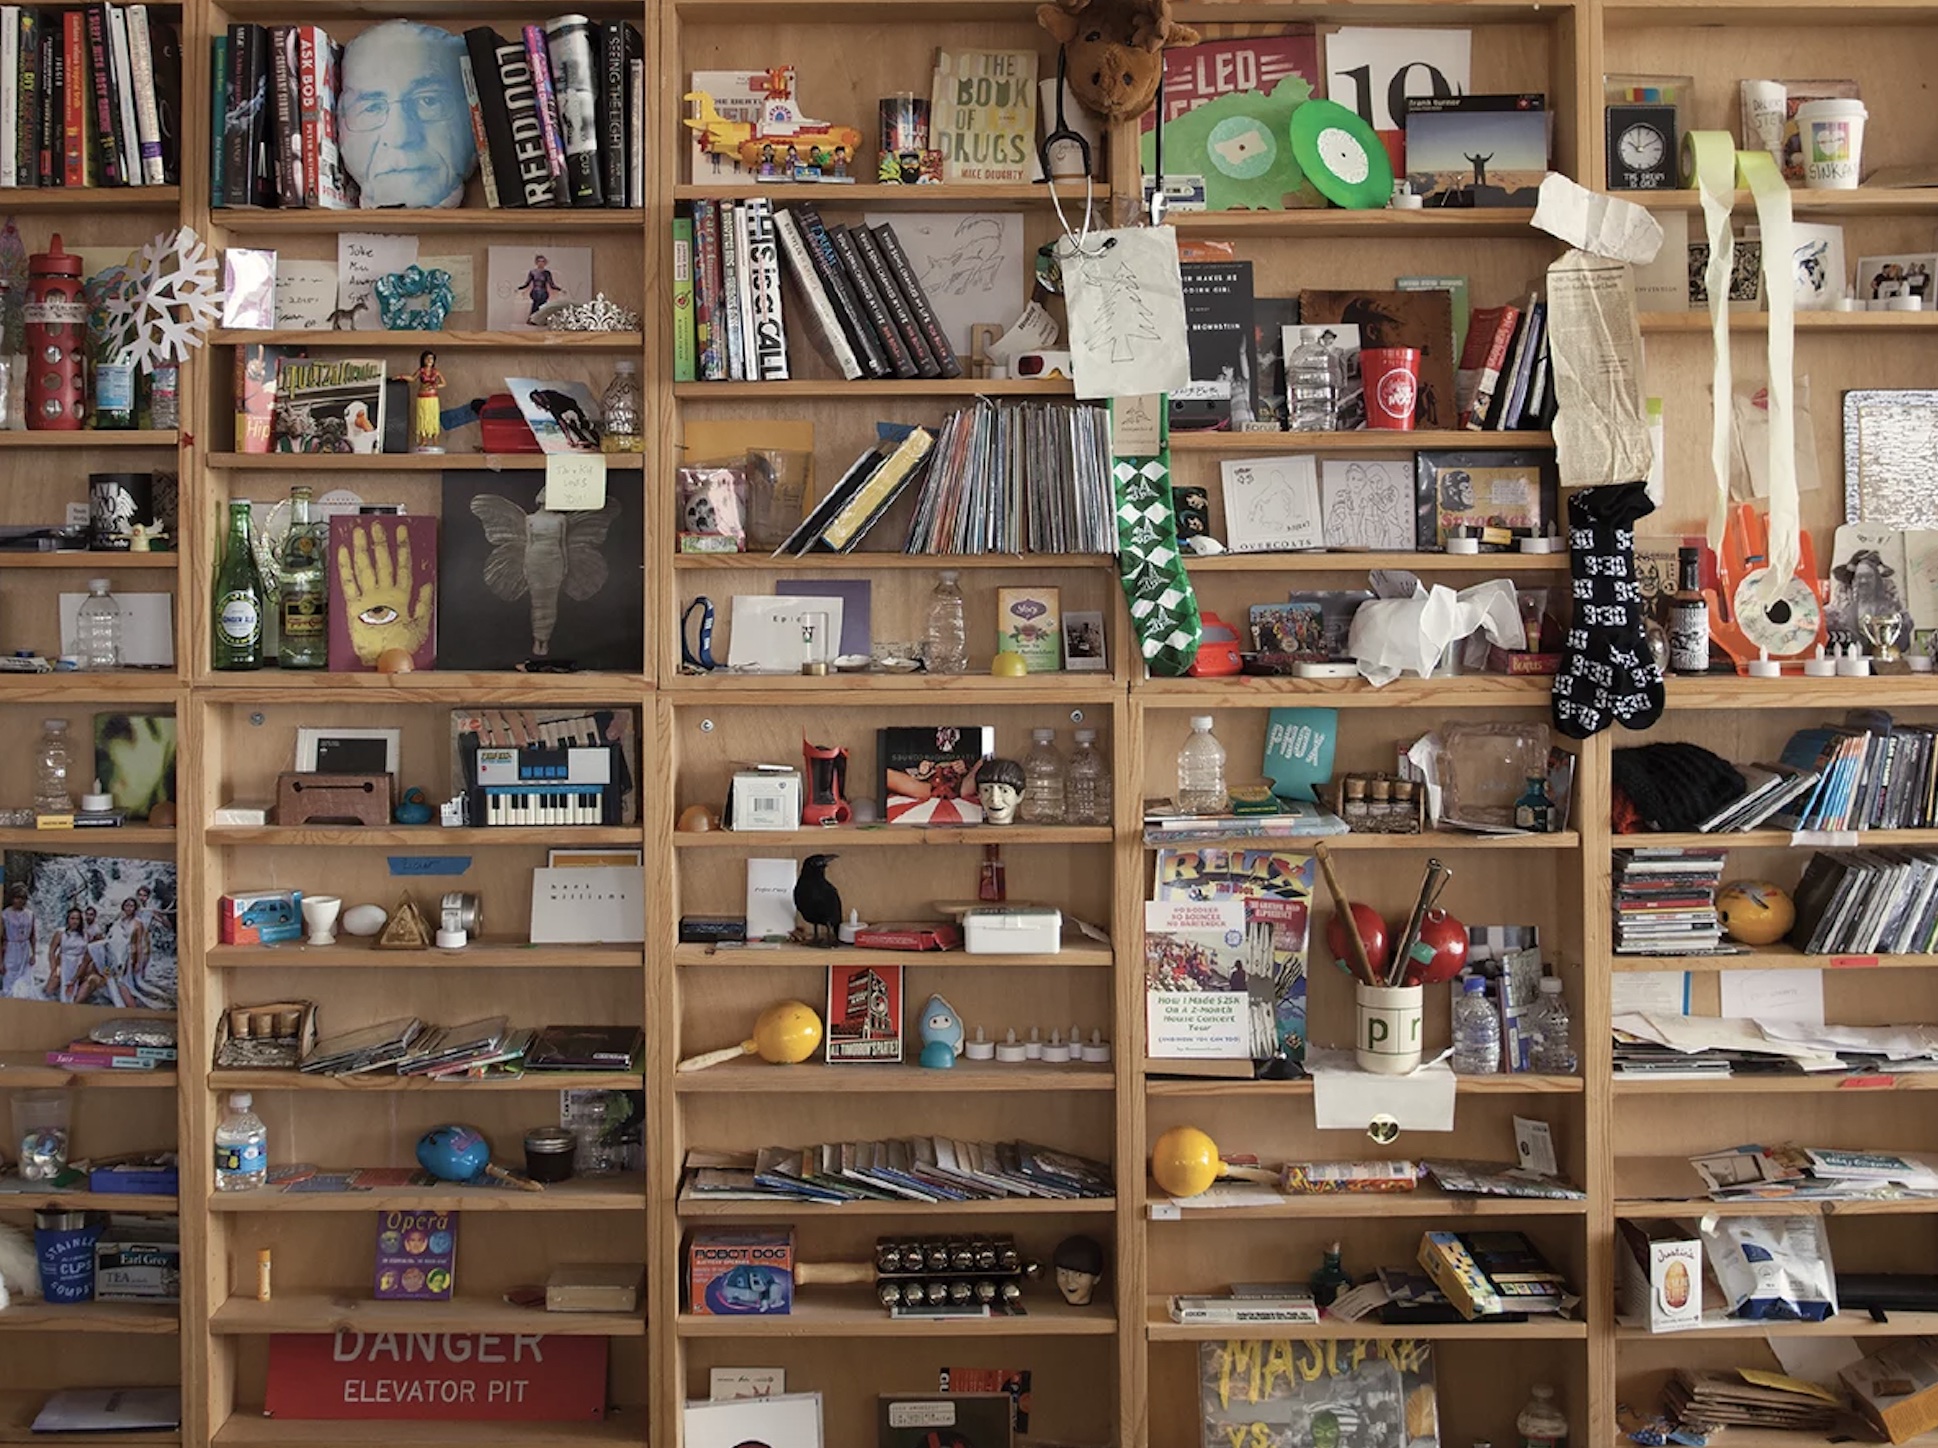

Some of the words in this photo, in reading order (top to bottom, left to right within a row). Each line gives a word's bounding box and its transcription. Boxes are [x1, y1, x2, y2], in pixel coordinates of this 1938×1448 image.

[301, 39, 313, 69] ASK
[608, 37, 621, 83] SEEING
[983, 55, 1015, 75] THE
[24, 72, 35, 92] DIY
[1197, 50, 1257, 94] LED
[302, 75, 314, 107] BOB
[609, 87, 621, 107] THE
[957, 78, 1028, 108] BOOK
[608, 111, 621, 149] LIGHT
[956, 109, 976, 130] OF
[939, 132, 1026, 163] DRUGS
[512, 117, 552, 205] REED
[961, 169, 981, 180] MIKE
[985, 168, 1024, 180] DOUGHTY
[746, 199, 777, 263] THIS
[758, 318, 785, 379] CALL
[247, 420, 270, 441] Hip
[1240, 539, 1312, 551] OVERCOATS
[1584, 555, 1627, 577] 9:30
[1583, 604, 1627, 626] 9:30
[1266, 723, 1326, 767] PHOX
[1162, 852, 1310, 897] RELIX
[1157, 996, 1180, 1005] How
[1189, 996, 1216, 1005] Made
[1191, 1005, 1234, 1014] 2-Month
[1163, 1015, 1194, 1023] House
[1196, 1015, 1236, 1023] Concert
[1188, 1024, 1212, 1032] Tour
[387, 1211, 449, 1233] Opera
[120, 1253, 141, 1265] Earl
[143, 1253, 167, 1266] Grey
[694, 1249, 749, 1259] ROBOT
[752, 1249, 787, 1259] DOG
[60, 1260, 92, 1275] CUPS
[106, 1272, 130, 1283] TEA
[333, 1333, 544, 1363] DANGER
[344, 1379, 476, 1403] ELEVATOR
[488, 1380, 529, 1403] PIT
